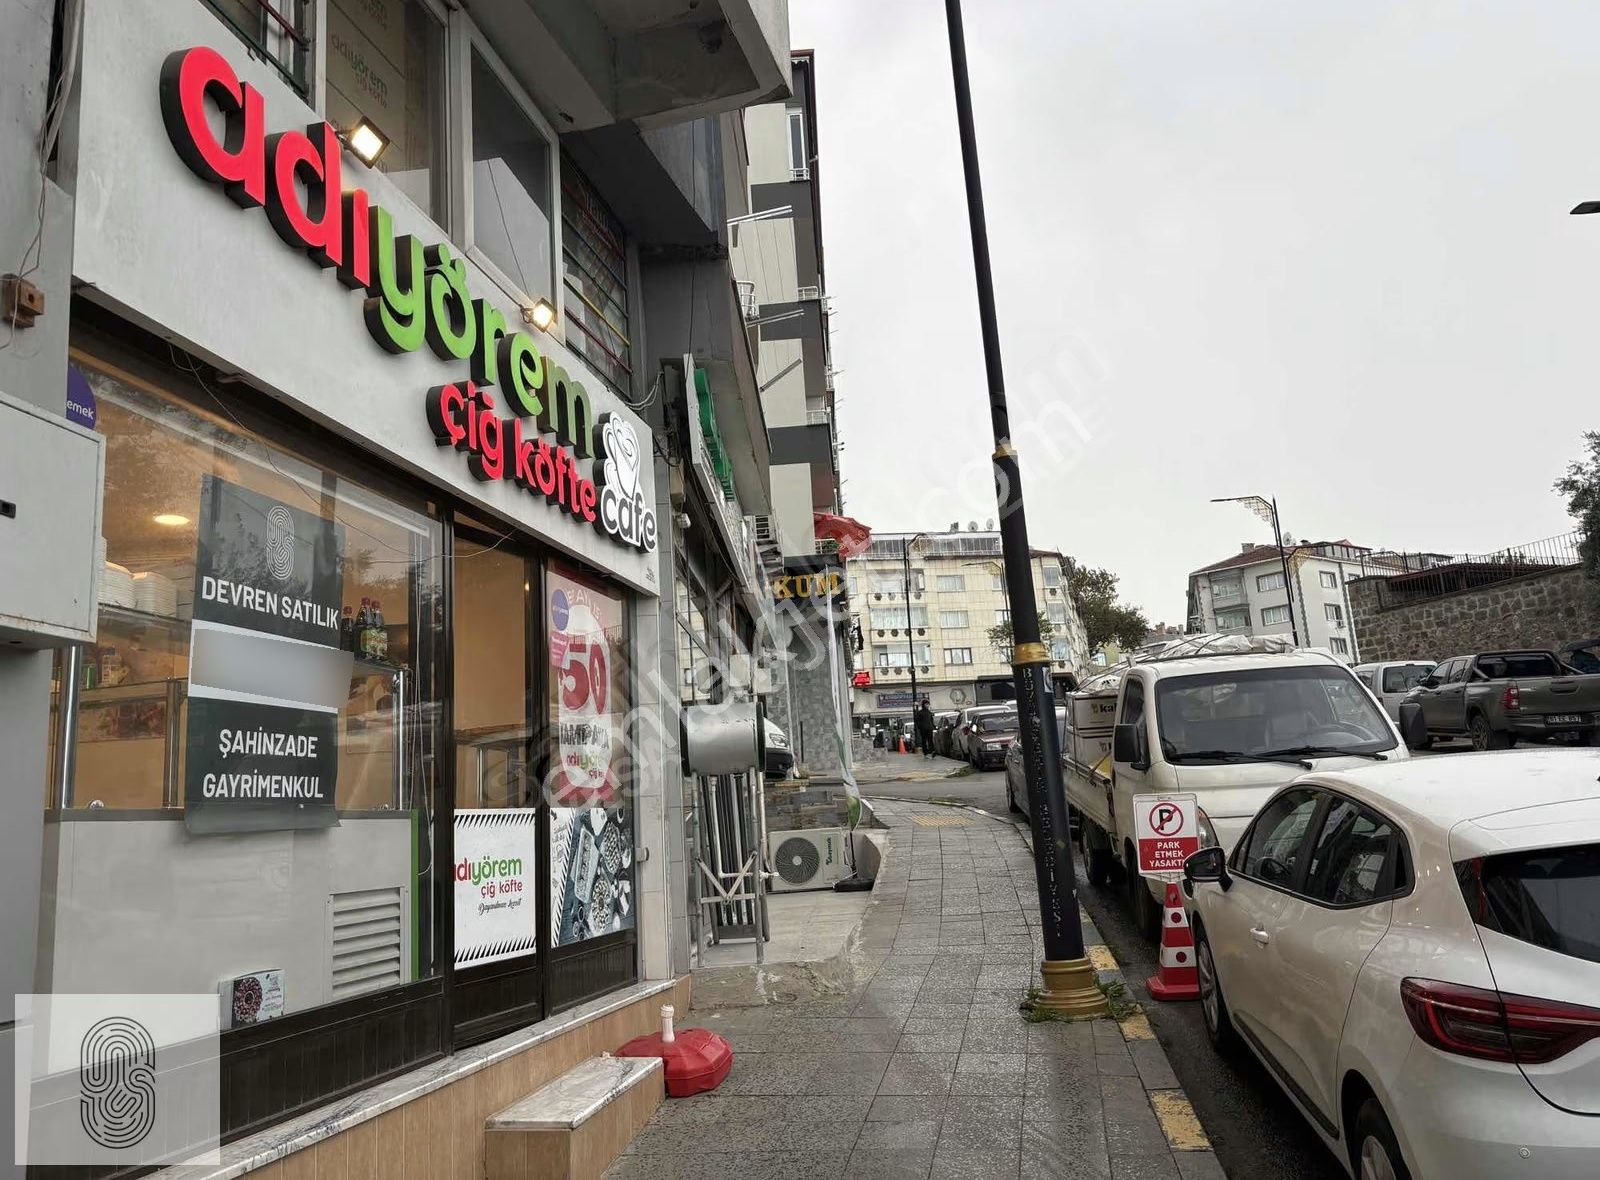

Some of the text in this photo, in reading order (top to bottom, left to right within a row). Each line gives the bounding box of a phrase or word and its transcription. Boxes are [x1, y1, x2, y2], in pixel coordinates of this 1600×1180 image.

[160, 45, 594, 460] adıyörem
[66, 400, 95, 420] emek
[502, 418, 597, 522] köfte
[600, 486, 657, 553] cafe
[202, 575, 339, 631] DEVREN SATILIK
[1100, 702, 1117, 713] kal
[218, 726, 319, 760] ŞAHİNZADE
[202, 768, 324, 800] GAYRİMENKUL
[1154, 850, 1184, 859] ETMEK
[1157, 841, 1180, 849] PARK
[1149, 859, 1186, 868] YASAKTI
[499, 879, 523, 894] köfte
